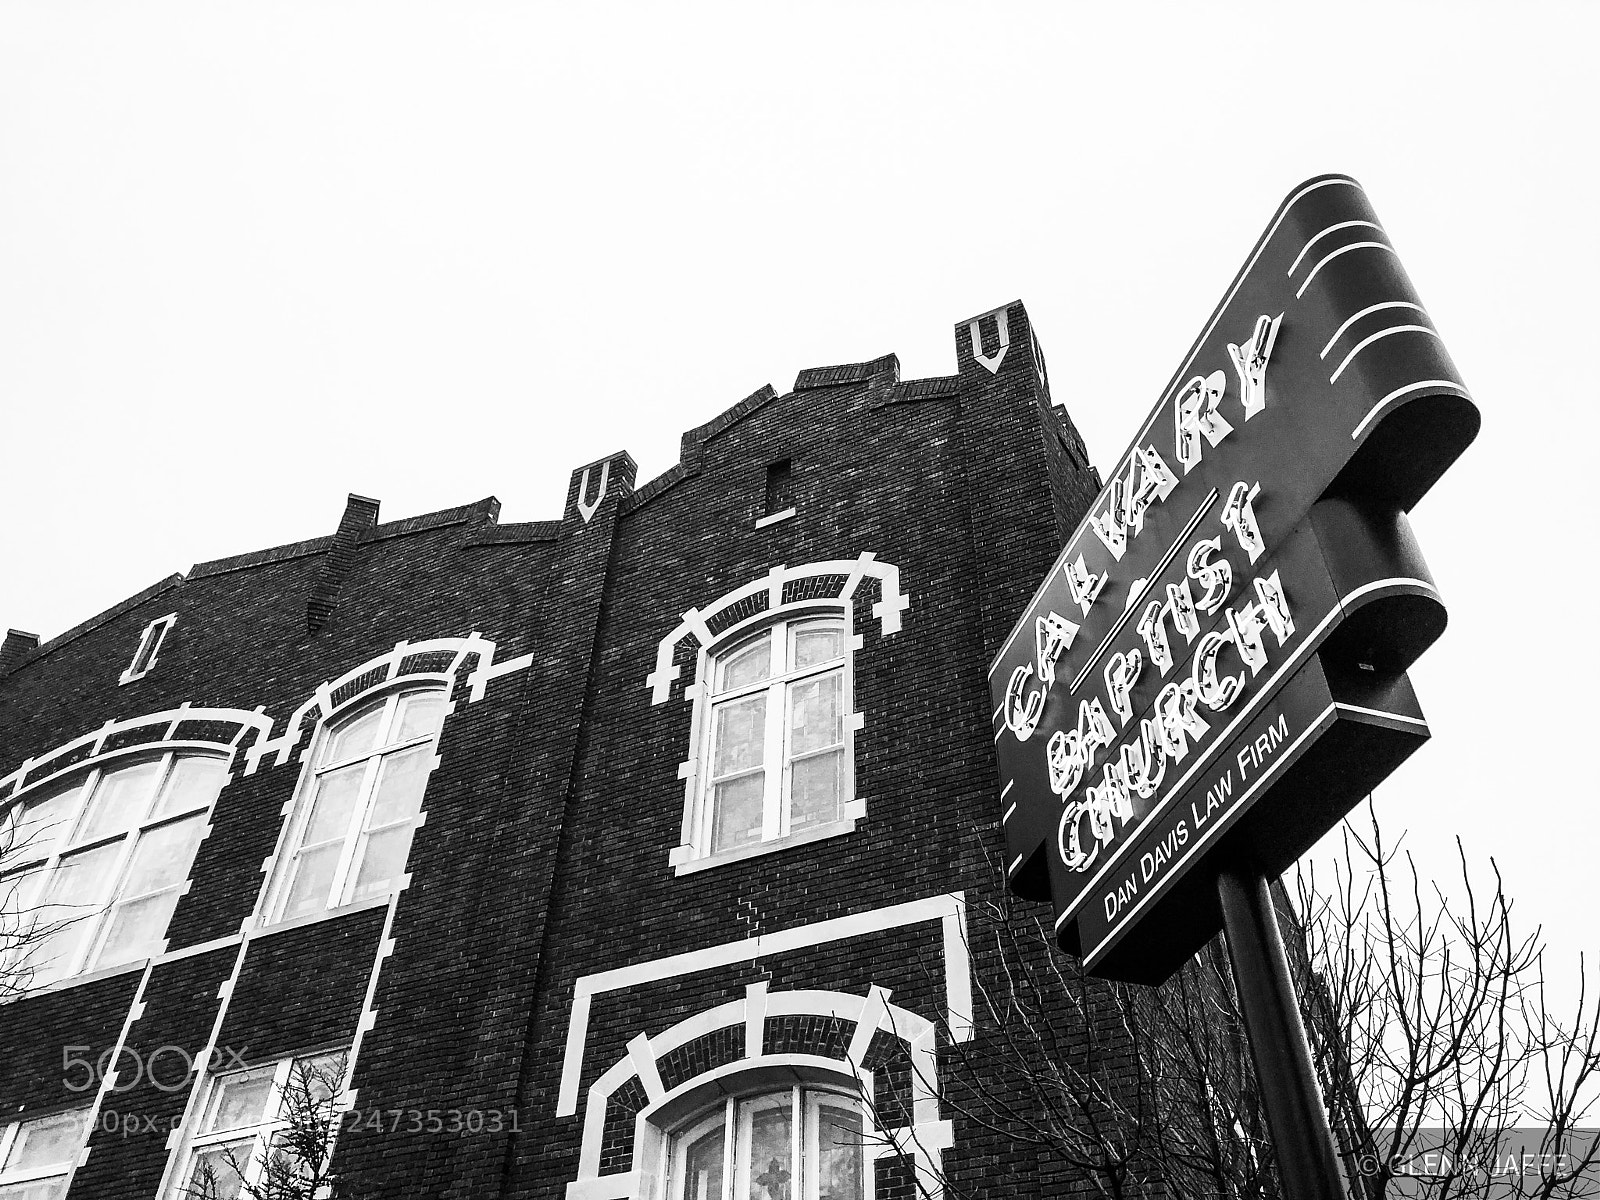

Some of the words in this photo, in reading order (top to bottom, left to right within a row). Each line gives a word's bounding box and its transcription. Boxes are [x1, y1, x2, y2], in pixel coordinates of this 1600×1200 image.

[1004, 311, 1285, 742] CALVARY
[1047, 481, 1266, 803] BAPTIST
[1058, 568, 1296, 873] CHURCH
